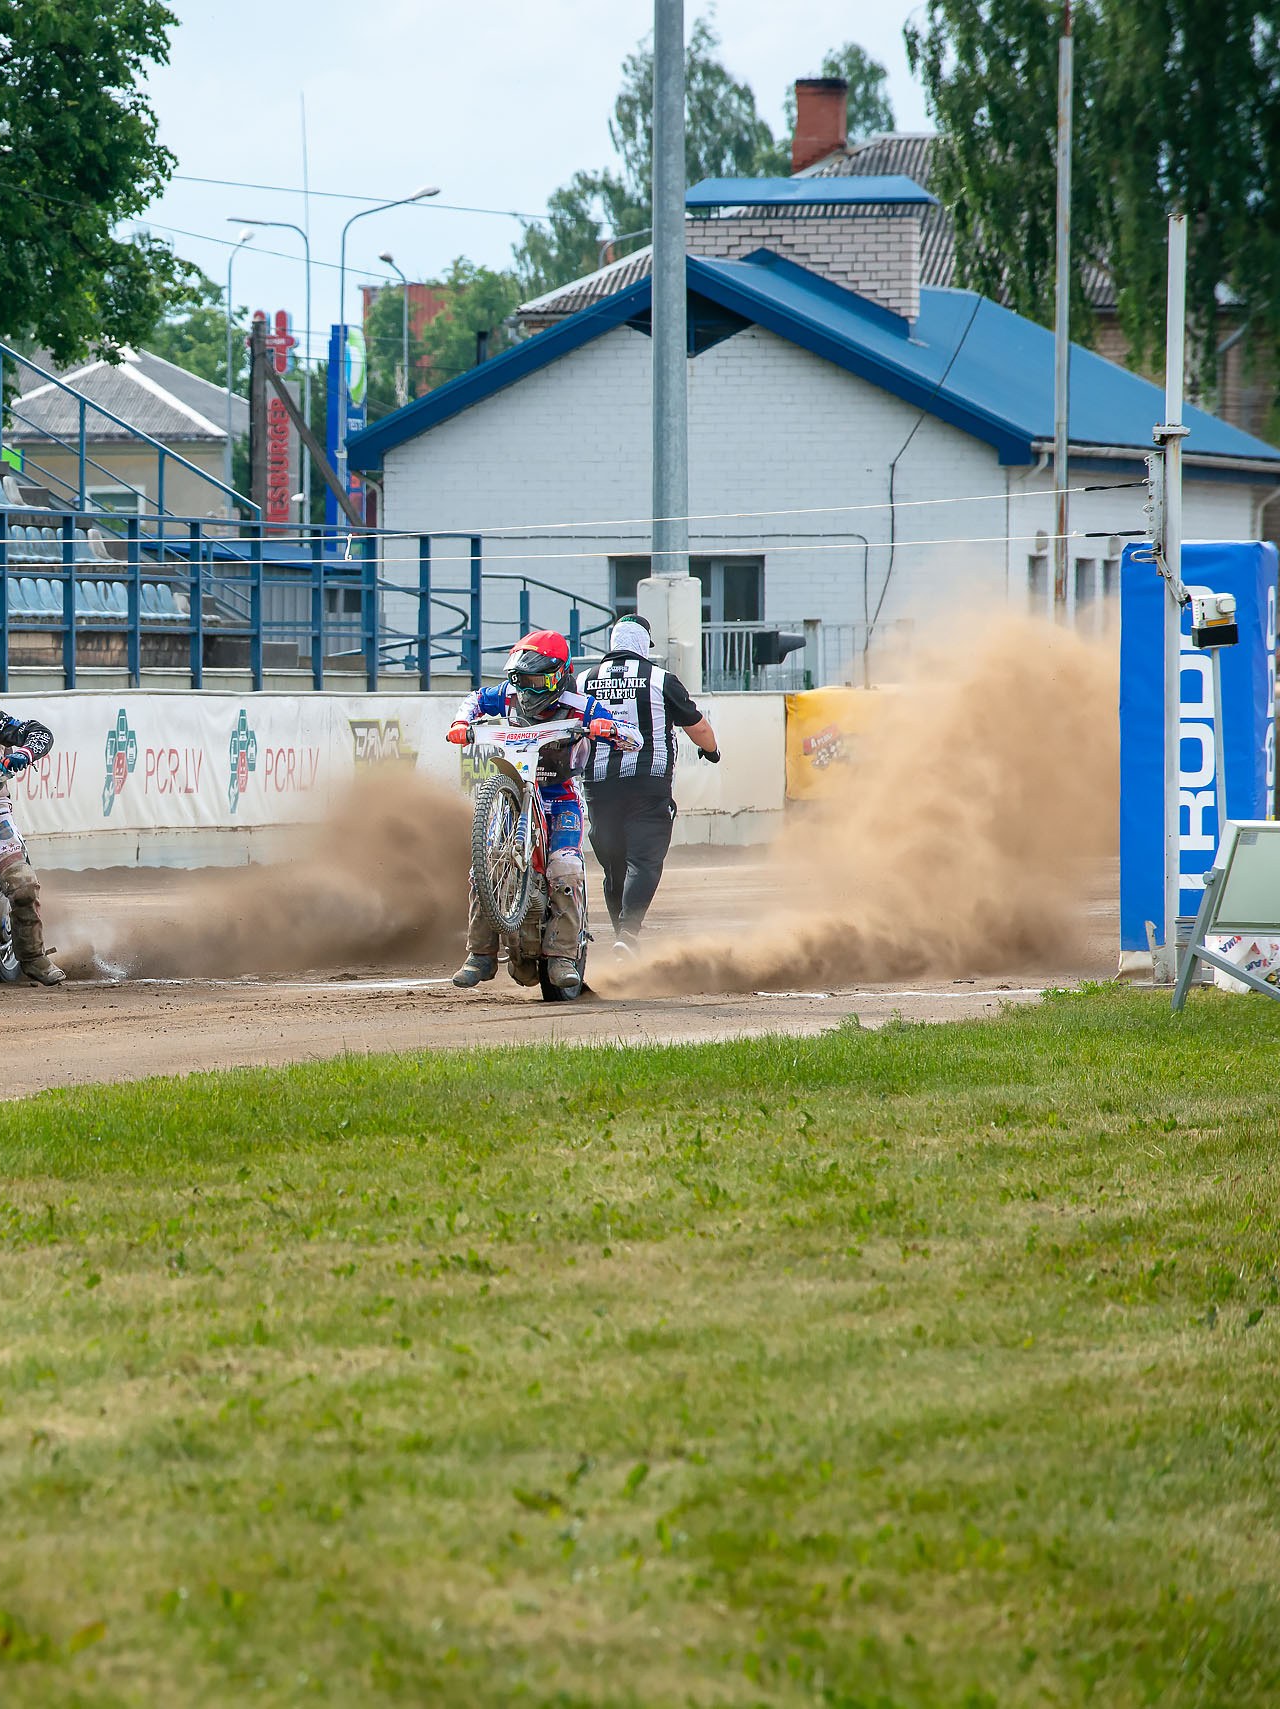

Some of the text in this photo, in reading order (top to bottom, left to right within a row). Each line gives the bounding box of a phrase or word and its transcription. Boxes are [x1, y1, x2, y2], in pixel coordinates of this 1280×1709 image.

[586, 678, 647, 690] KIEROWNIK
[595, 688, 637, 700] STARTU
[1179, 585, 1216, 891] RODO
[16, 752, 77, 800] PCR.LV
[145, 748, 202, 794] PCR.LV
